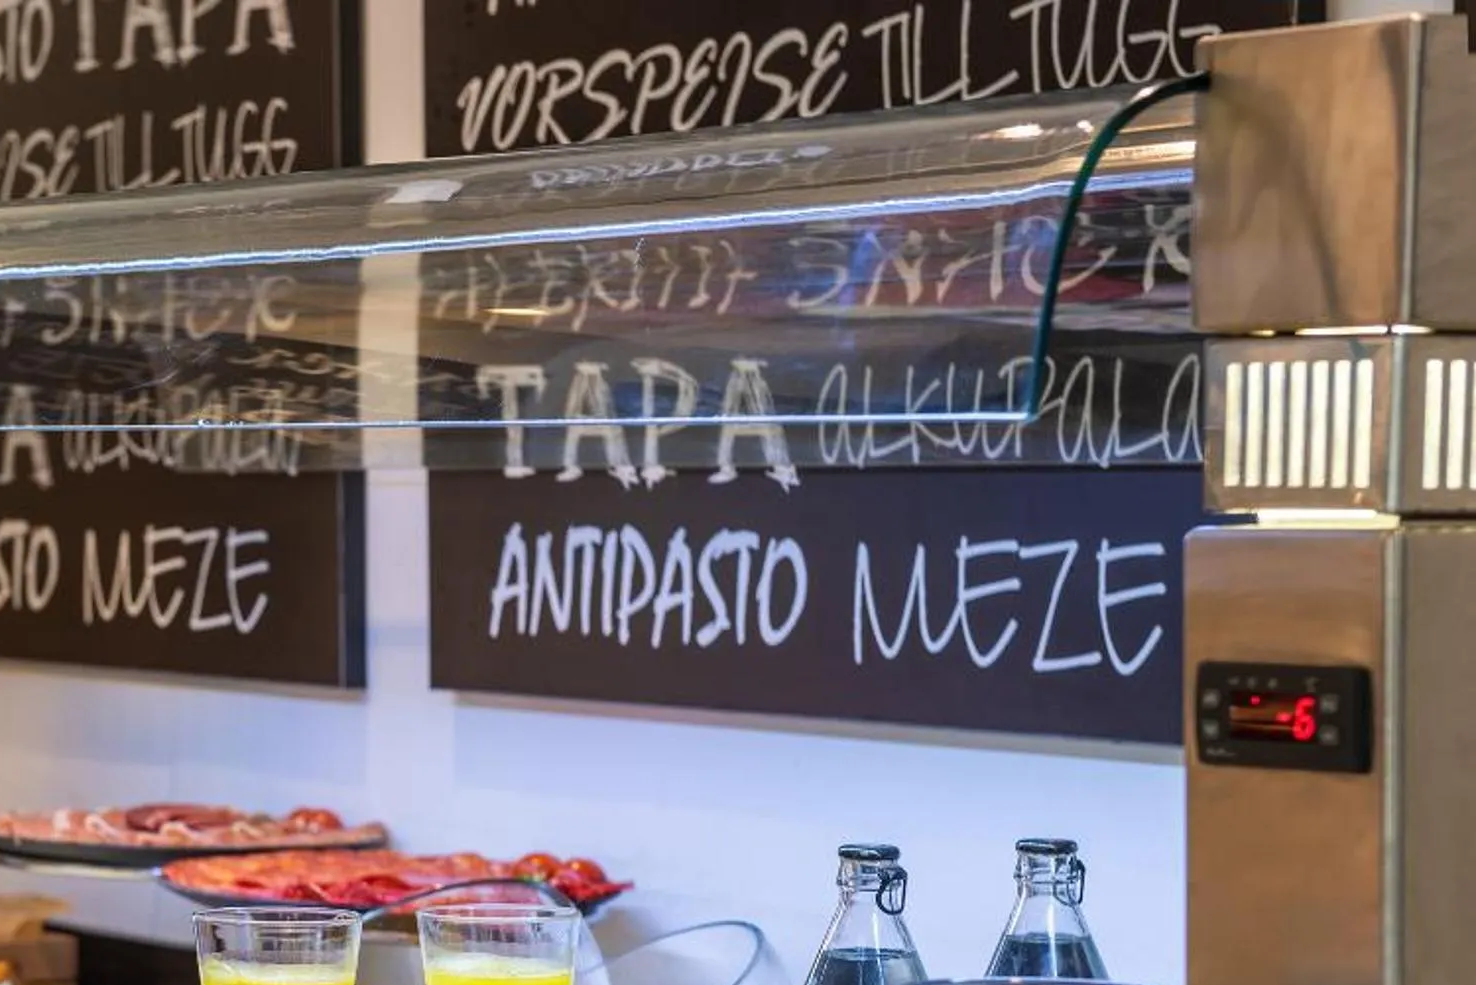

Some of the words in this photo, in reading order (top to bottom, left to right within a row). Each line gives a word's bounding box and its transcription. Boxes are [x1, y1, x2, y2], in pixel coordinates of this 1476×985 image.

[456, 22, 848, 153] VORSPEISE
[862, 2, 1020, 107] TILL
[476, 358, 802, 494] TAPA
[82, 525, 272, 634] MEZE
[489, 523, 809, 650] ANTIPASTO
[853, 536, 1167, 676] MEZE
[1276, 695, 1316, 741] -6
